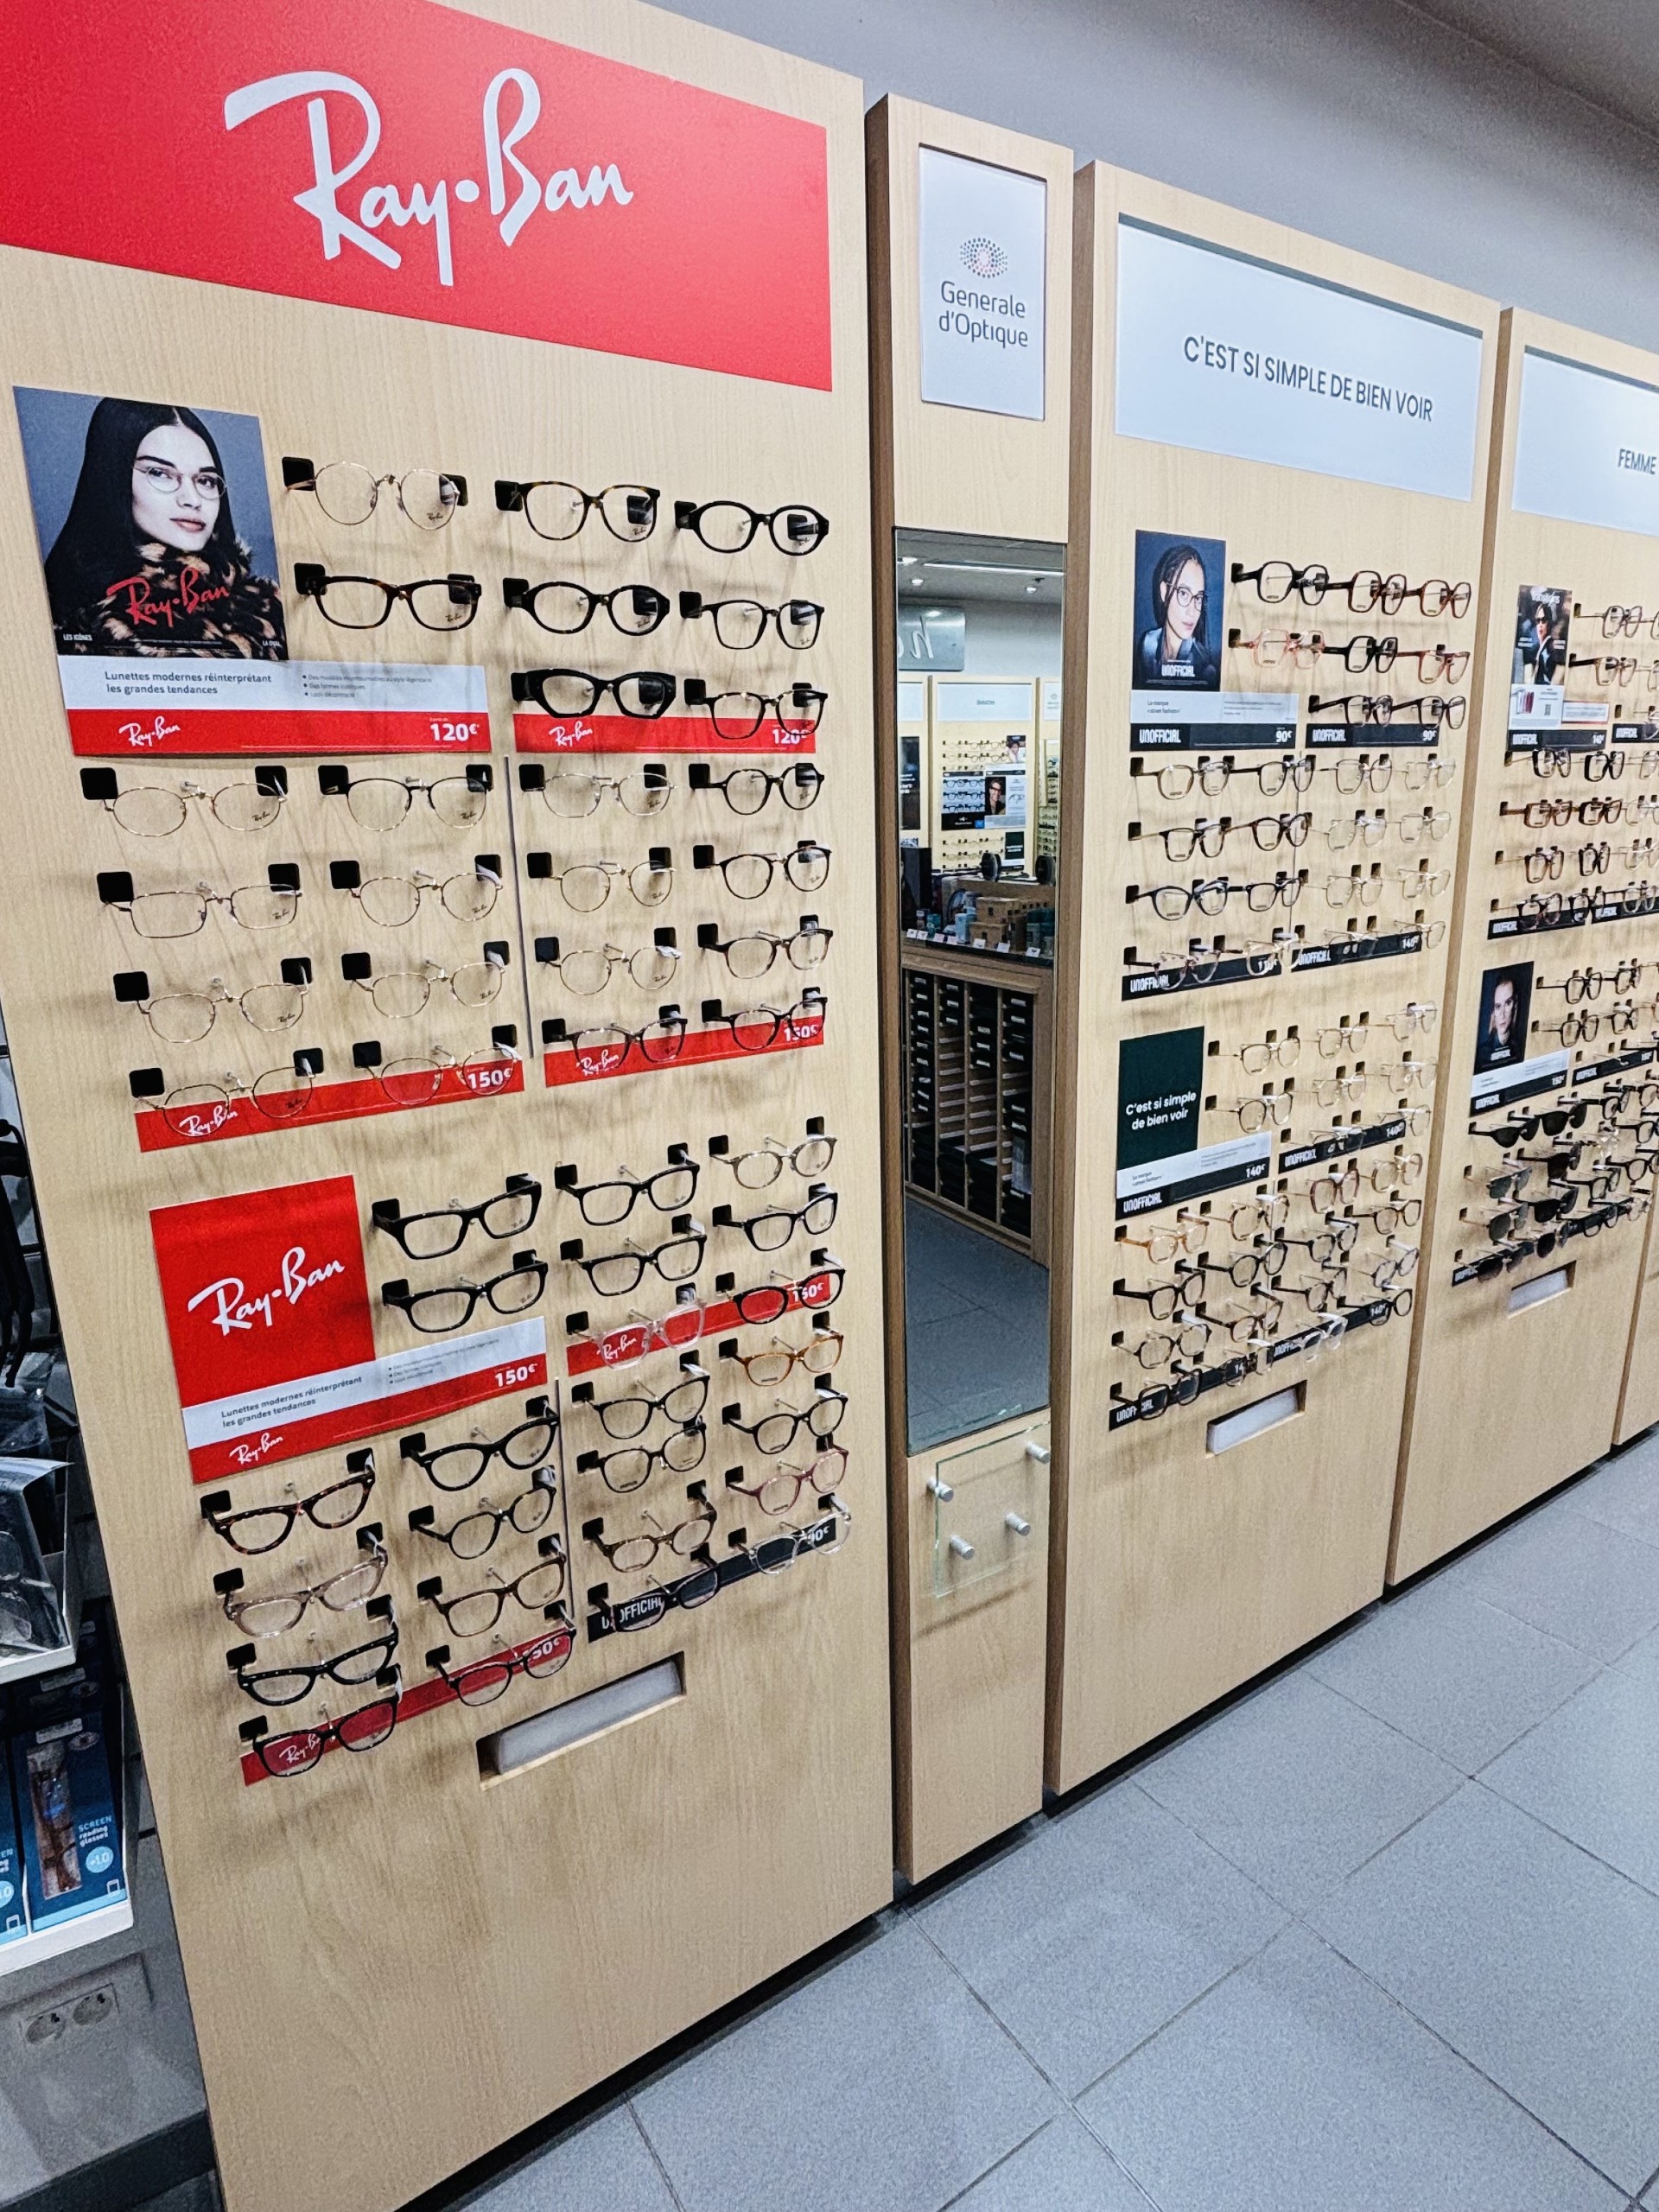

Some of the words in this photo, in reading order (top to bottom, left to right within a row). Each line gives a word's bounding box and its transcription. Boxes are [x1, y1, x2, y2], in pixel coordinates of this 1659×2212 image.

[941, 281, 1026, 319] Generale
[938, 311, 1028, 348] d'Optique
[1184, 335, 1239, 372] C'EST
[1243, 351, 1259, 378] SI
[1265, 357, 1326, 395] SIMPLE
[1331, 373, 1352, 401] DE
[1356, 381, 1391, 411] BIEN
[1395, 391, 1433, 422] VOIR
[1618, 448, 1657, 475] FEMME
[105, 671, 149, 681] Lunettes
[152, 672, 202, 682] modernes
[204, 673, 272, 683] réinterprétant
[106, 683, 122, 693] les
[124, 684, 165, 695] grandes
[167, 685, 218, 694] tendances
[1139, 729, 1181, 744] UNOFFICIAL
[467, 1067, 512, 1089] 150€
[1126, 1101, 1153, 1116] C'est
[1154, 1096, 1162, 1109] si
[1163, 1090, 1197, 1109] simple
[1132, 1118, 1145, 1130] de
[1146, 1112, 1168, 1128] bien
[1170, 1108, 1189, 1122] voir
[221, 1403, 259, 1418] Lunettes
[261, 1391, 303, 1408] modernes
[305, 1376, 363, 1396] réinterprétant
[222, 1418, 236, 1427] les
[237, 1410, 272, 1426] grandes
[273, 1398, 316, 1415] tendances
[79, 1815, 112, 1833] SCREEN
